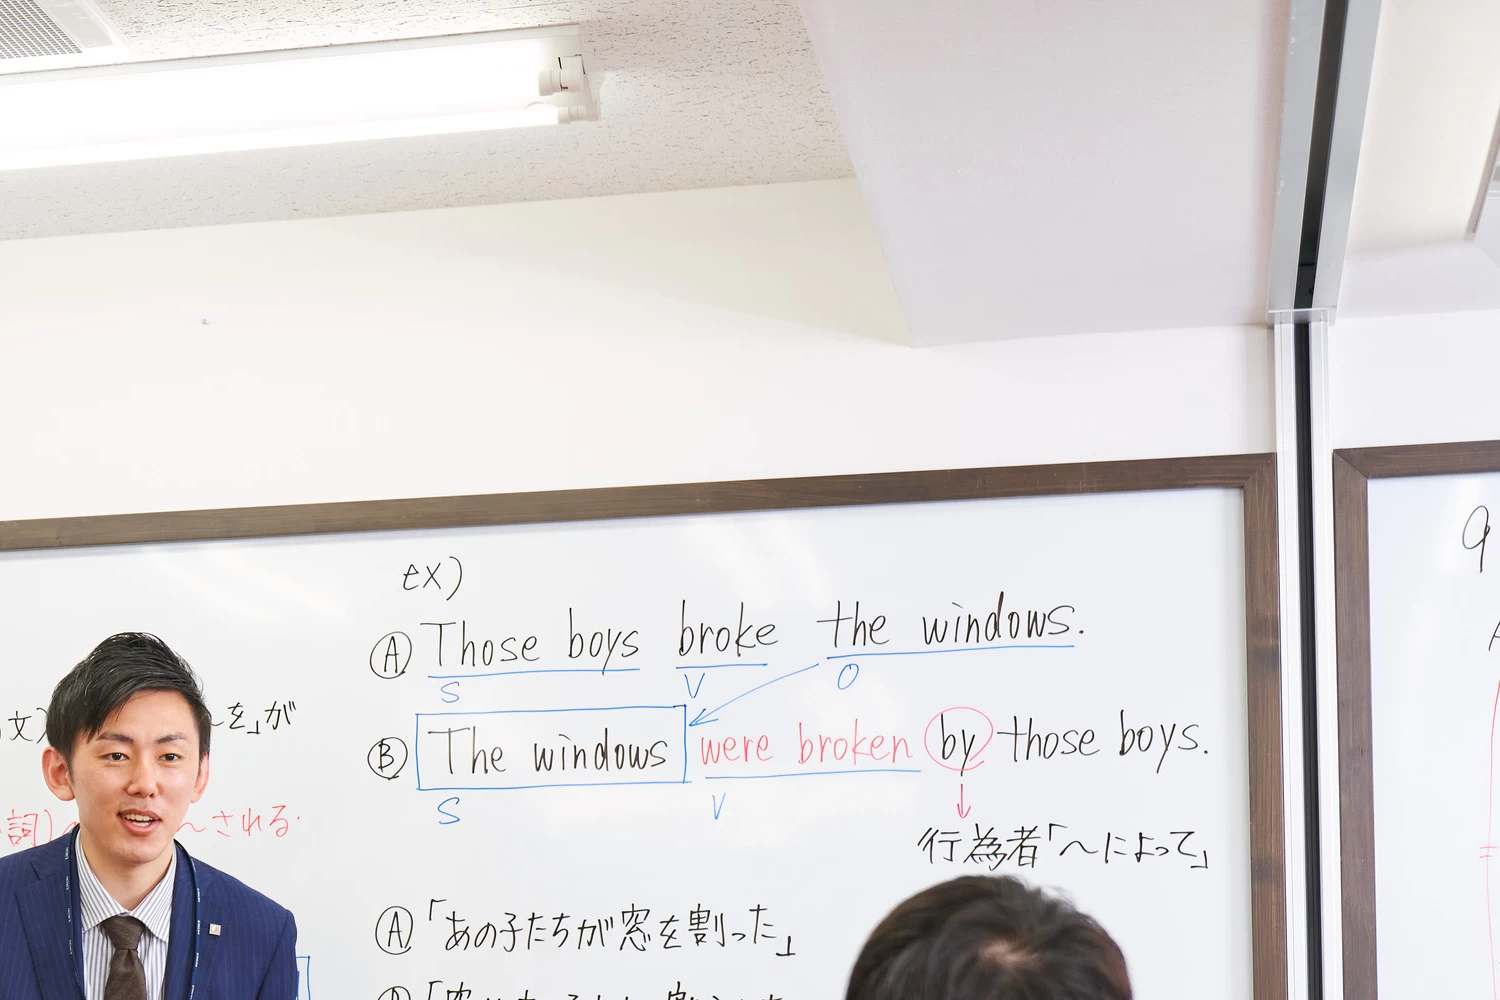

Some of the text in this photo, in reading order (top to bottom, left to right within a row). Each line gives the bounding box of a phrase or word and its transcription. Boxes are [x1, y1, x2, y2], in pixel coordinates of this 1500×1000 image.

[403, 556, 463, 601] ex)
[420, 620, 541, 670] Those
[568, 608, 639, 675] boys
[679, 600, 779, 658] broke
[816, 600, 890, 649] the
[922, 591, 1085, 646] windows.
[441, 682, 461, 704] S
[684, 673, 706, 698] V
[428, 726, 507, 775] The
[534, 728, 668, 773] windows
[701, 734, 772, 766] were
[798, 718, 913, 766] broken
[941, 714, 976, 778] by
[997, 716, 1101, 763] those
[1118, 709, 1209, 774] boys.
[438, 793, 727, 825] S V
[429, 898, 796, 957] 「あの子たちが窓を割った」
